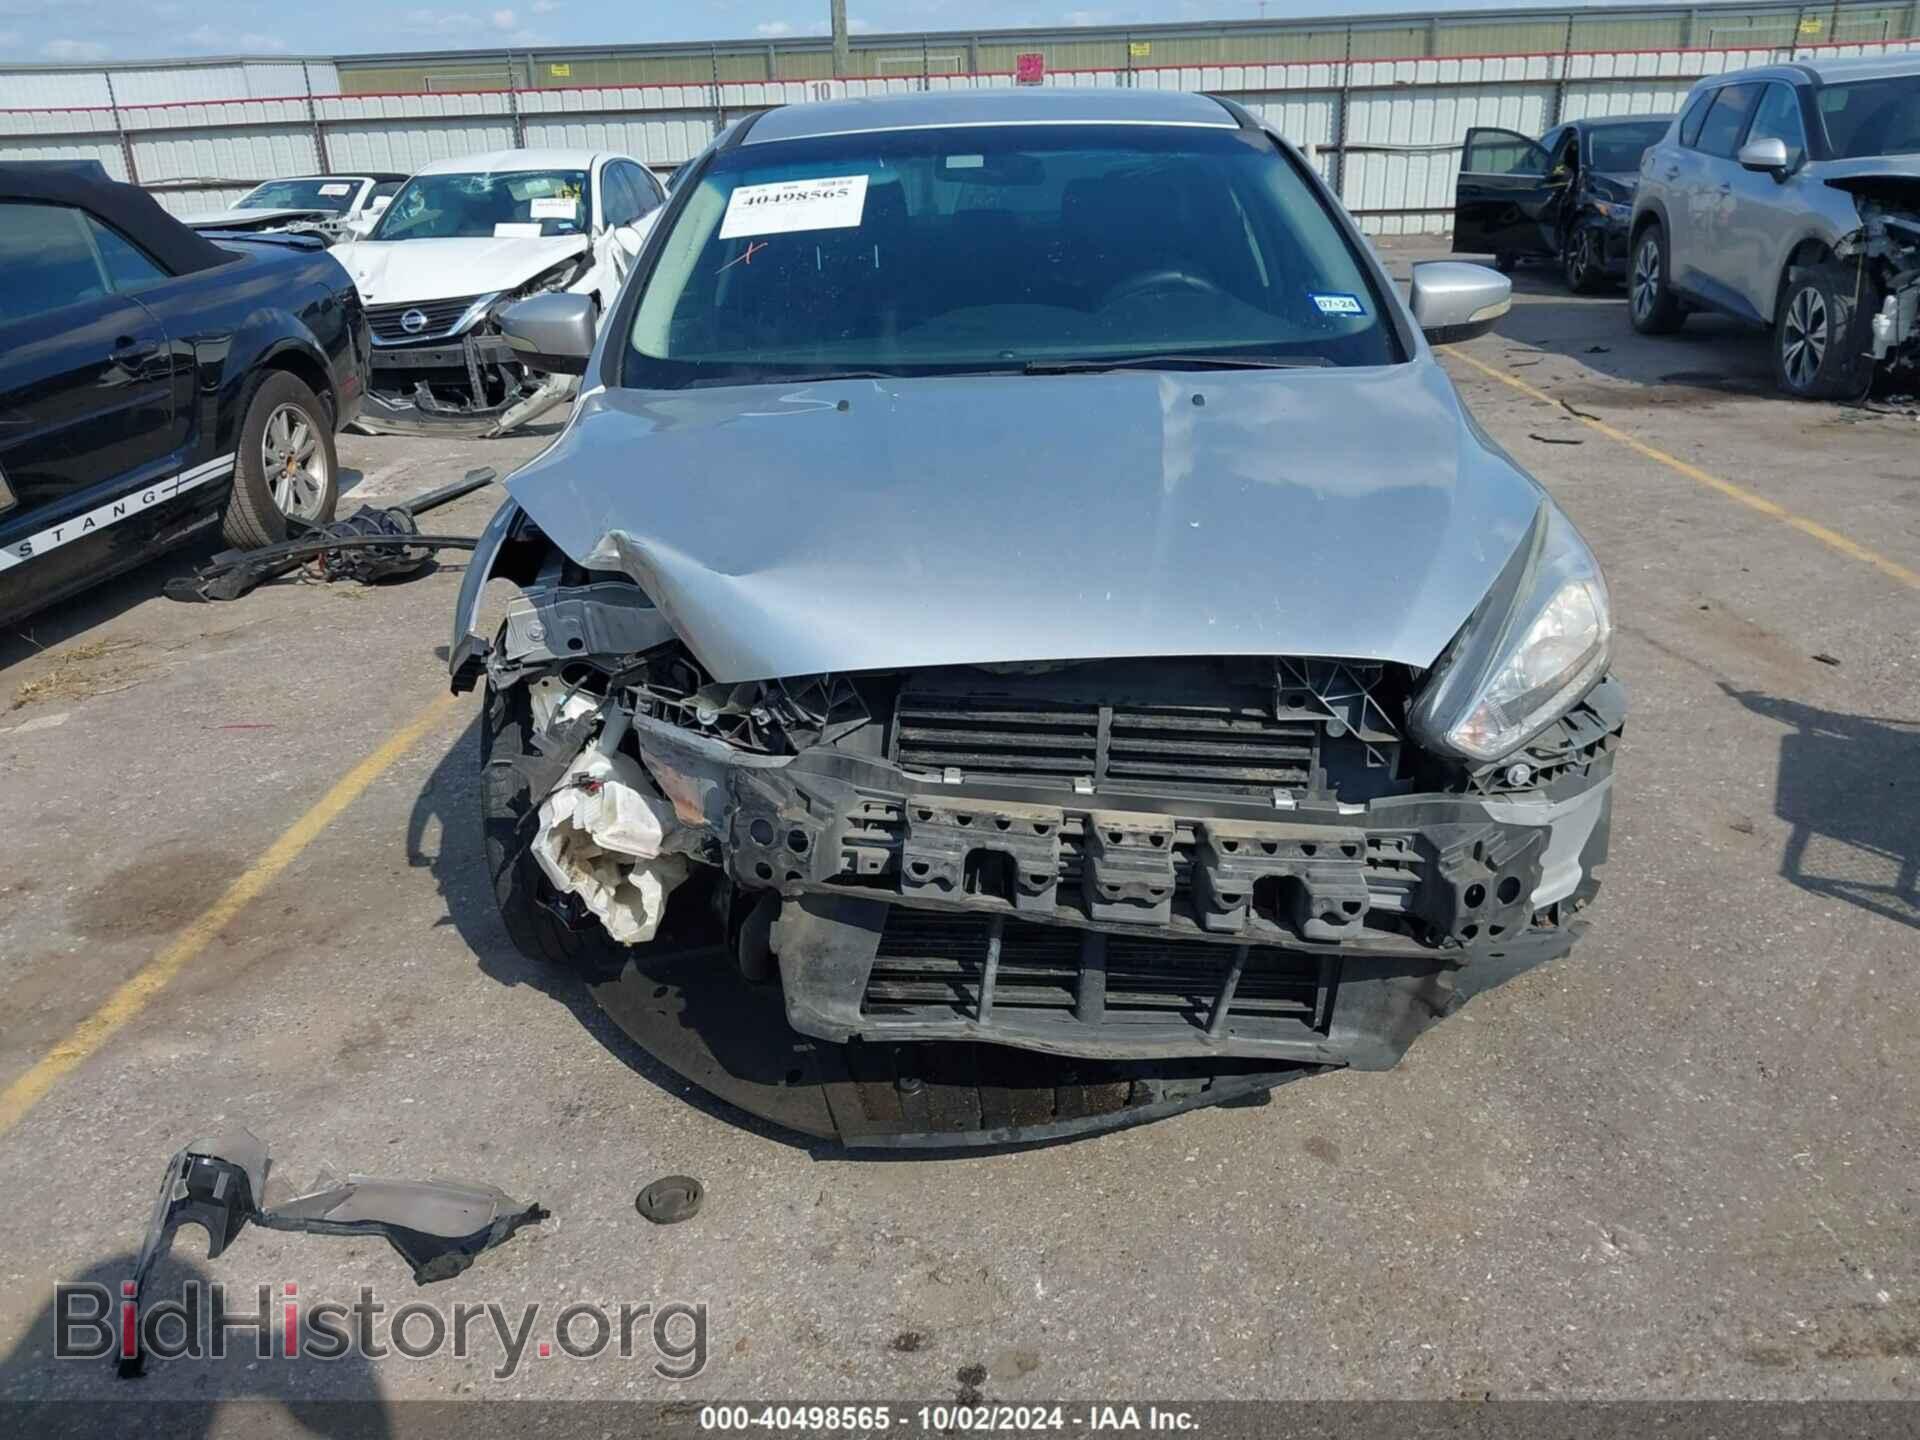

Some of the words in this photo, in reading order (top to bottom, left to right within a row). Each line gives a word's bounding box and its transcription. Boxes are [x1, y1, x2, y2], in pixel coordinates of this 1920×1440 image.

[811, 82, 832, 101] 10
[743, 187, 849, 206] 40498565
[19, 490, 157, 558] STANG
